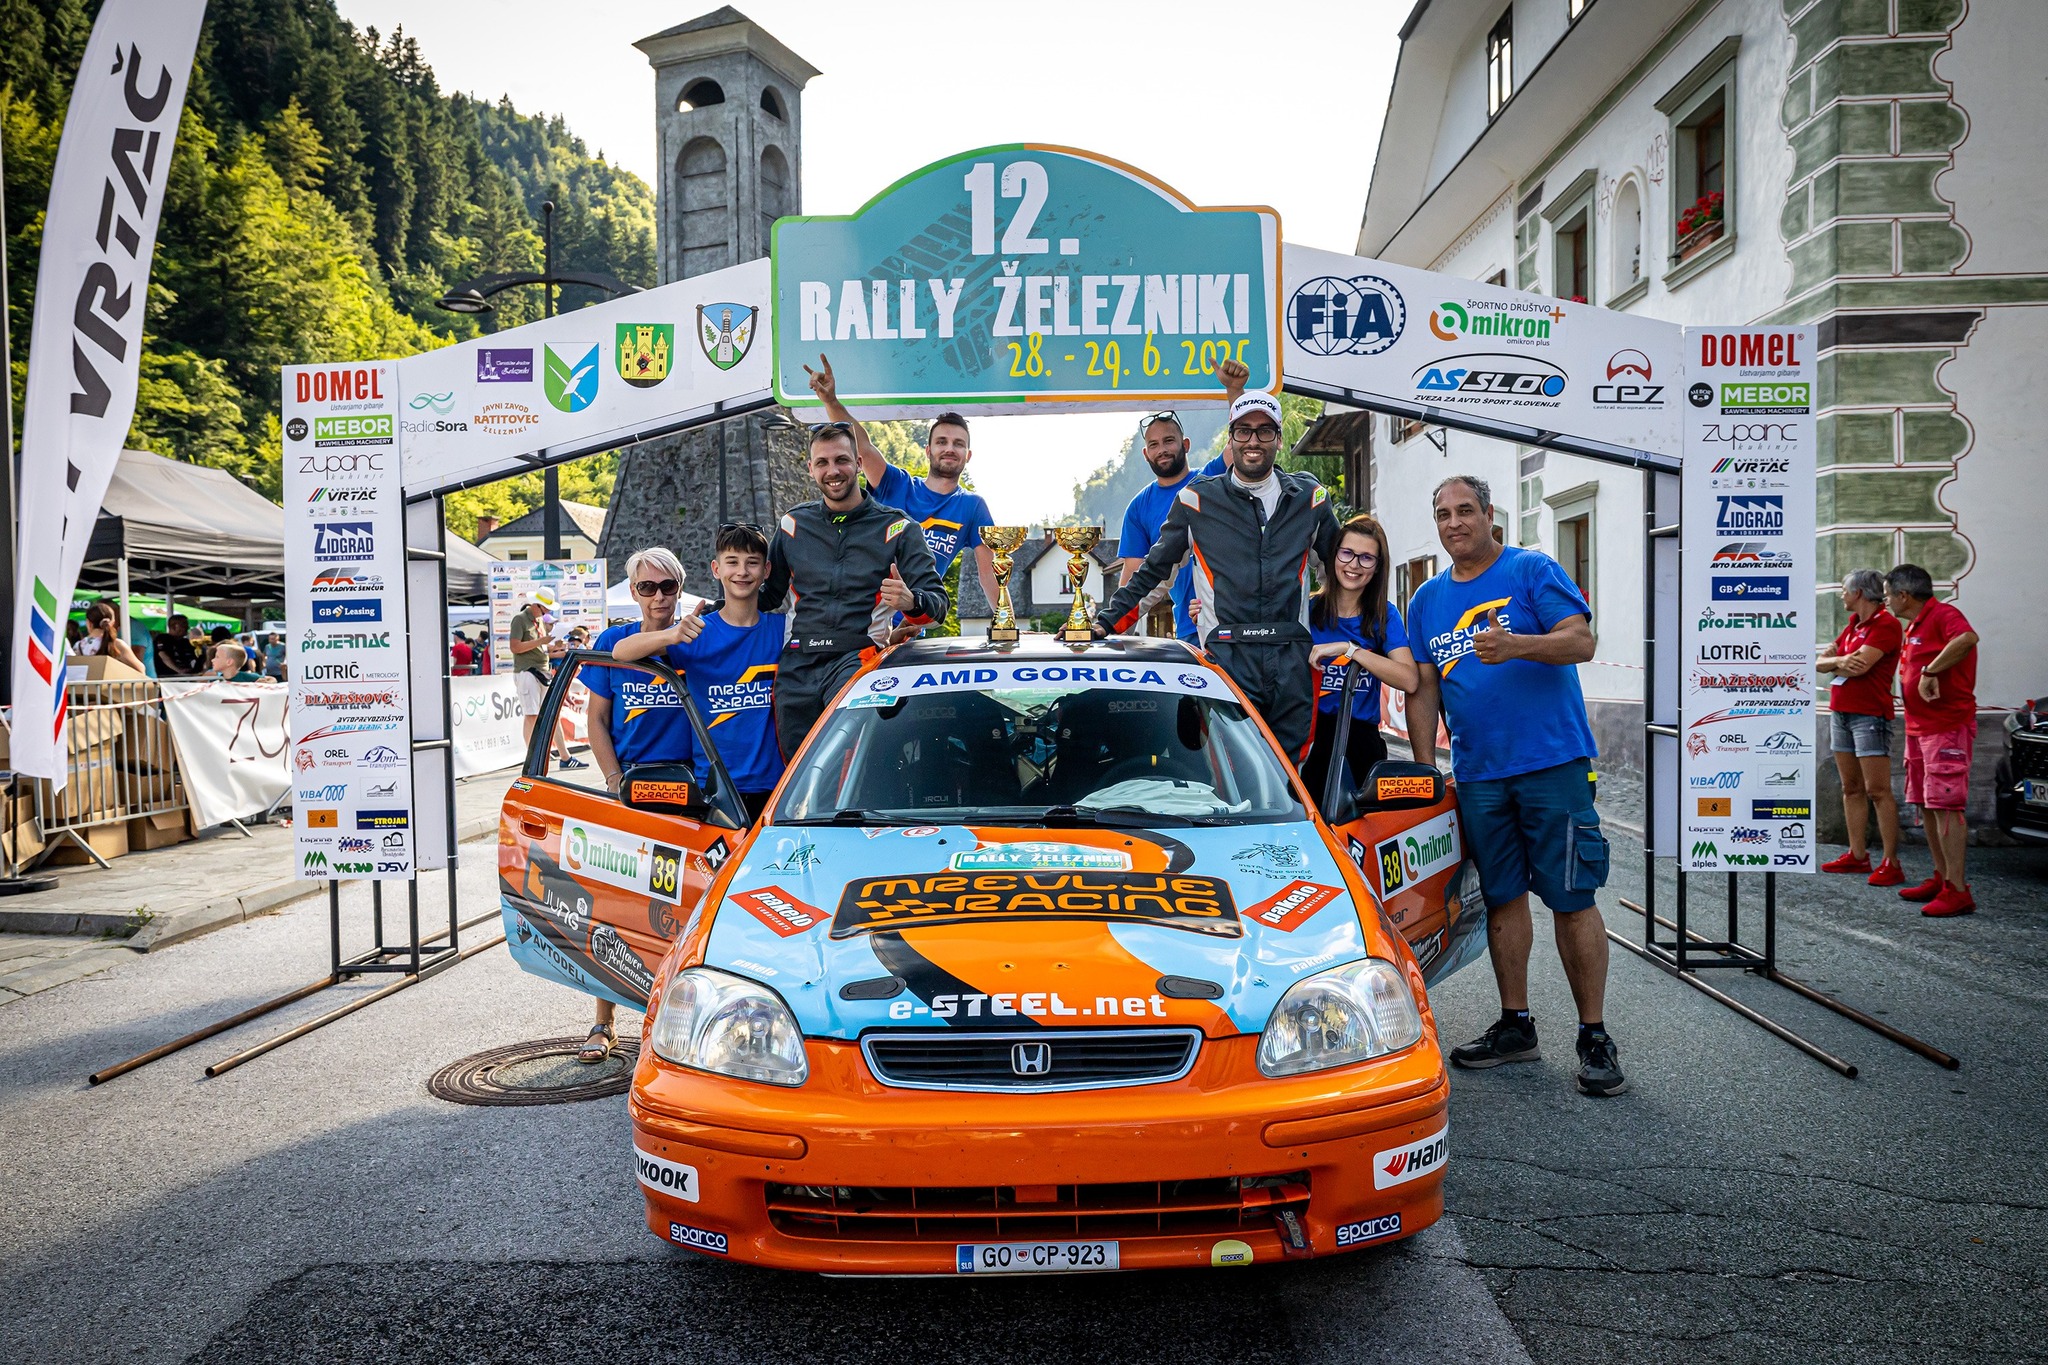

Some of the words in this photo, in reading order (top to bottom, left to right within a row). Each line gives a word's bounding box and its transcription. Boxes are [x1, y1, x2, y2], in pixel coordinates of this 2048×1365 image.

[964, 160, 1080, 256] 12.
[70, 42, 173, 418] VRTAČ
[800, 278, 966, 341] RALLY
[992, 260, 1250, 337] ŽELEZNIKI
[1466, 299, 1508, 311] ŠPORTNO
[1509, 301, 1552, 314] DRUŠTVO
[1007, 331, 1053, 377] 28.
[1085, 340, 1130, 388] 29.
[1143, 329, 1170, 376] 6.
[1777, 369, 1801, 378] gibanje
[1724, 386, 1807, 403] MEBOR
[330, 403, 363, 411] Ustvarjamo
[363, 402, 384, 410] gibanje
[1235, 399, 1277, 412] Hankook
[1414, 394, 1443, 403] ZVEZA
[1444, 395, 1455, 404] ZA
[1457, 396, 1480, 405] AVTO
[1482, 396, 1511, 407] ŠPORT
[1512, 399, 1562, 408] SLOVENIJE
[482, 402, 503, 414] JAVNI
[504, 402, 530, 413] ZAVOD
[474, 414, 539, 424] RATITOVEC
[317, 418, 390, 436] MEBOR
[483, 425, 528, 435] ŽELEZNIKI
[318, 440, 355, 448] SAWMILLING
[356, 438, 391, 446] MACHINERY
[1716, 496, 1783, 528] ZIDGRAD
[314, 523, 374, 554] ZIDGRAD
[1763, 560, 1793, 568] ŠENČUR
[358, 583, 384, 591] ŠENČUR
[1719, 586, 1733, 594] GB
[1747, 585, 1782, 595] Leasing
[319, 608, 332, 616] GB
[344, 607, 375, 616] Leasing
[1429, 614, 1510, 649] MREVLE
[911, 669, 998, 688] AMD
[1013, 667, 1166, 686] GORICA
[643, 694, 682, 705] RACI
[1719, 734, 1747, 743] OREL
[324, 749, 350, 759] OREL
[634, 783, 686, 792] MREVLJE
[1380, 779, 1432, 787] MREVLJE
[648, 791, 686, 800] RACING
[1394, 786, 1432, 794] RACING
[1772, 807, 1809, 815] STROJAN
[374, 817, 407, 825] STROJAN
[1733, 829, 1770, 838] MBS
[340, 838, 373, 849] MBS
[1025, 844, 1060, 853] 38
[963, 854, 1022, 863] RALLY
[1031, 852, 1121, 863] ŽELEZNIKI
[1774, 854, 1810, 866] DSV
[378, 862, 409, 873] DSV
[1383, 850, 1401, 889] 38
[1692, 861, 1717, 869] alples
[304, 868, 327, 877] alples
[652, 855, 677, 893] 38
[859, 874, 1217, 898] MREVLJE
[954, 892, 1222, 917] RACING
[1260, 884, 1318, 924] pakelo
[1297, 889, 1330, 914] LUBRICANTS
[749, 892, 814, 927] pakelo
[756, 906, 792, 931] LUBRICANTS
[729, 959, 779, 977] pakelo
[889, 992, 1167, 1020] e-STEEL.net
[1337, 1215, 1400, 1243] sparco
[671, 1224, 727, 1248] sparco
[983, 1246, 1012, 1268] GO
[1032, 1244, 1106, 1266] CP-923
[1221, 1253, 1244, 1262] sparco
[961, 1262, 973, 1270] SLO
